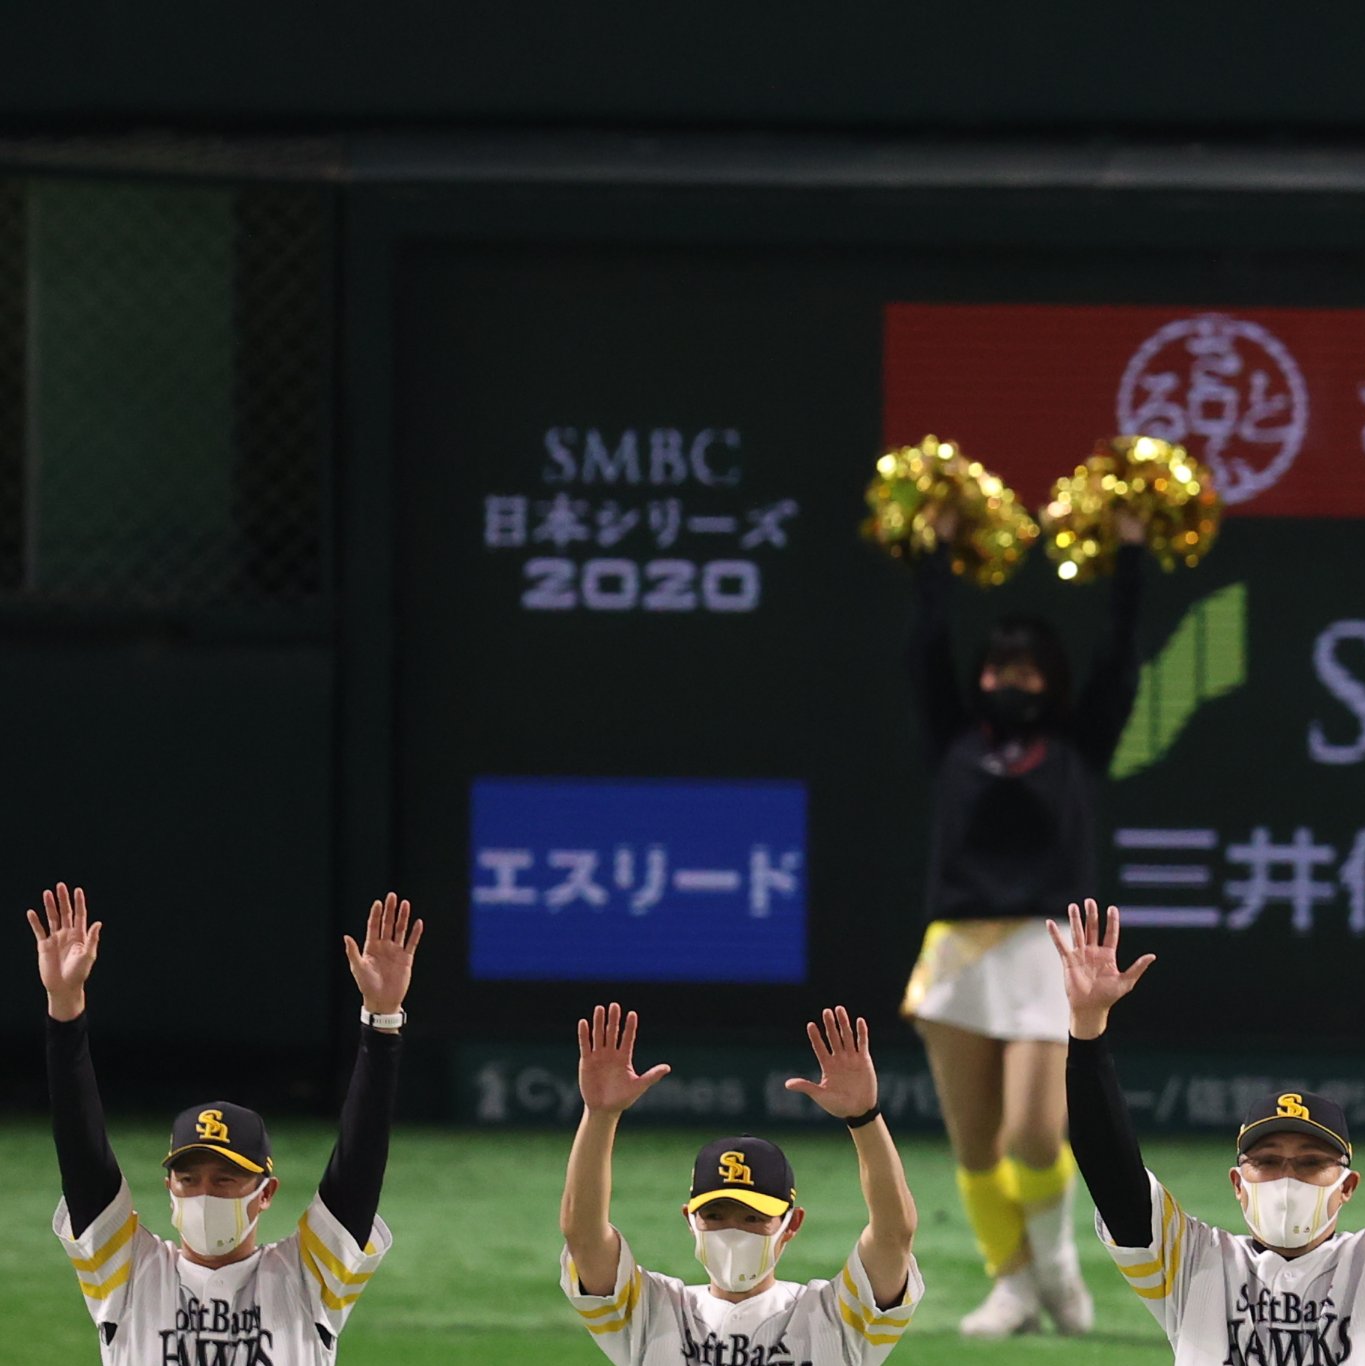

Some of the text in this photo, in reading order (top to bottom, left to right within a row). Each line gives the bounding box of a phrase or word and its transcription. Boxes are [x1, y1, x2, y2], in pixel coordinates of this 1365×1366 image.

[543, 427, 742, 486] SMBC
[484, 495, 796, 549] 日本シリーズ
[520, 558, 761, 614] 2020
[472, 844, 801, 917] エスリード
[174, 1297, 261, 1335] oftBan
[1236, 1283, 1334, 1325] SftBa
